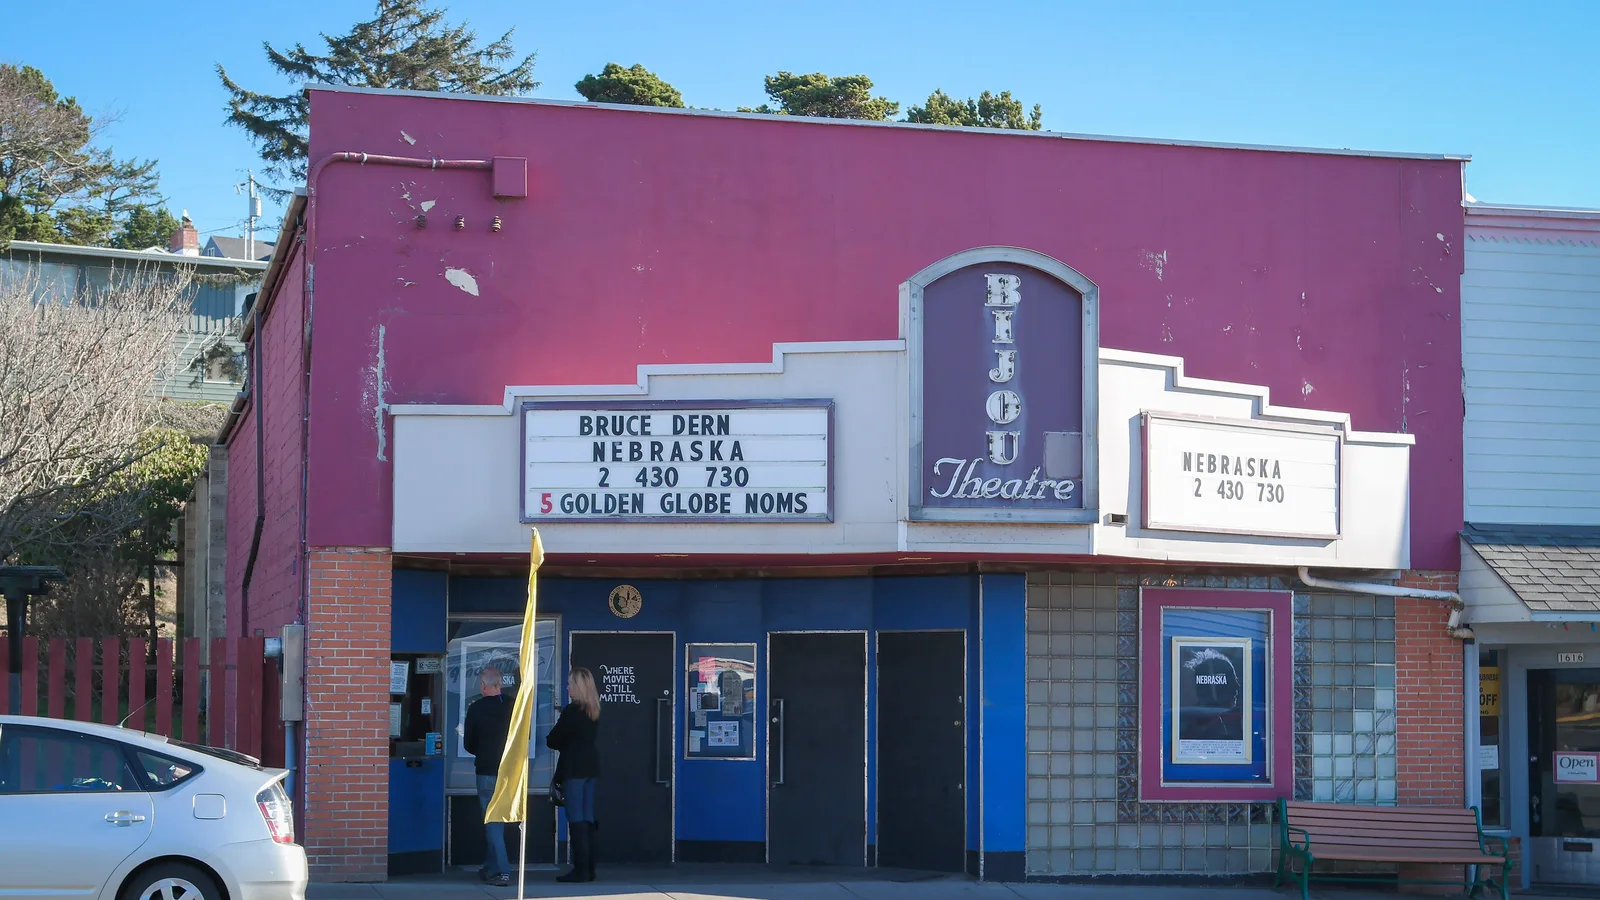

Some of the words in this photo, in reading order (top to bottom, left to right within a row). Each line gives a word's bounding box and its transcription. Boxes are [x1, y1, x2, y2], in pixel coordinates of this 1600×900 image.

[984, 273, 1022, 465] BIJOU
[579, 414, 652, 436] BRUCE
[672, 414, 730, 436] DERN
[592, 440, 744, 462] NEBRASKA
[1183, 451, 1282, 479] NEBRASKA
[599, 466, 610, 488] 2
[635, 466, 679, 488] 430
[705, 466, 749, 488] 730
[930, 456, 1075, 501] Theatre
[1194, 477, 1203, 498] 2
[1216, 479, 1244, 501] 430
[1257, 482, 1285, 503] 730
[540, 493, 553, 514] 5
[559, 493, 645, 514] GOLDEN
[659, 493, 731, 514] GLOBE
[745, 492, 808, 514] NOMS
[1560, 653, 1583, 662] 1616
[599, 664, 634, 675] WHERE
[602, 675, 636, 684] MOVIES
[605, 684, 633, 693] STILL
[1195, 675, 1228, 685] NEBRASKA
[599, 693, 641, 705] MATTER
[1479, 693, 1498, 706] OFF
[1559, 756, 1595, 770] Open
